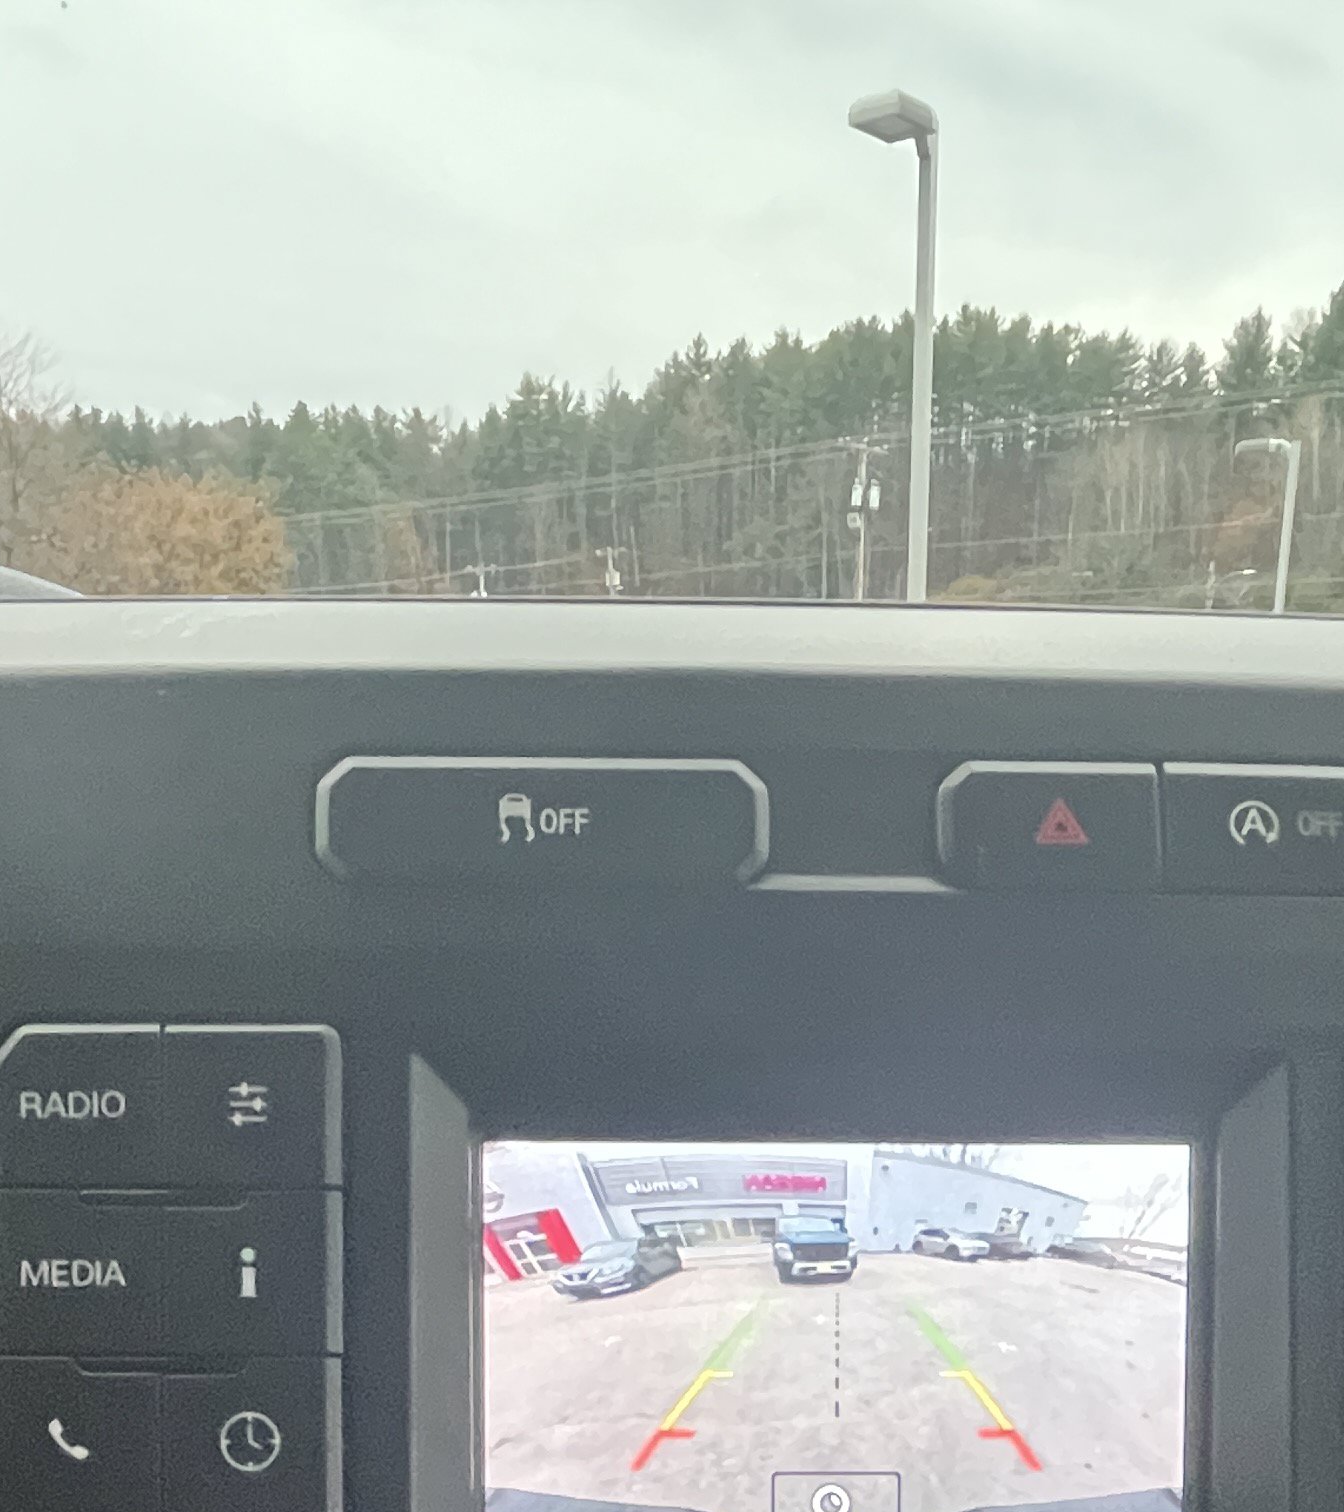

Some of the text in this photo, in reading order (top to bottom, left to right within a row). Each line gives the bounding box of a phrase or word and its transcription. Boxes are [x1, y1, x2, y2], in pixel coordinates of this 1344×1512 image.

[539, 807, 590, 835] OFF
[1296, 809, 1342, 838] OFF
[19, 1089, 126, 1119] RADIO
[20, 1259, 128, 1288] MEDIA
